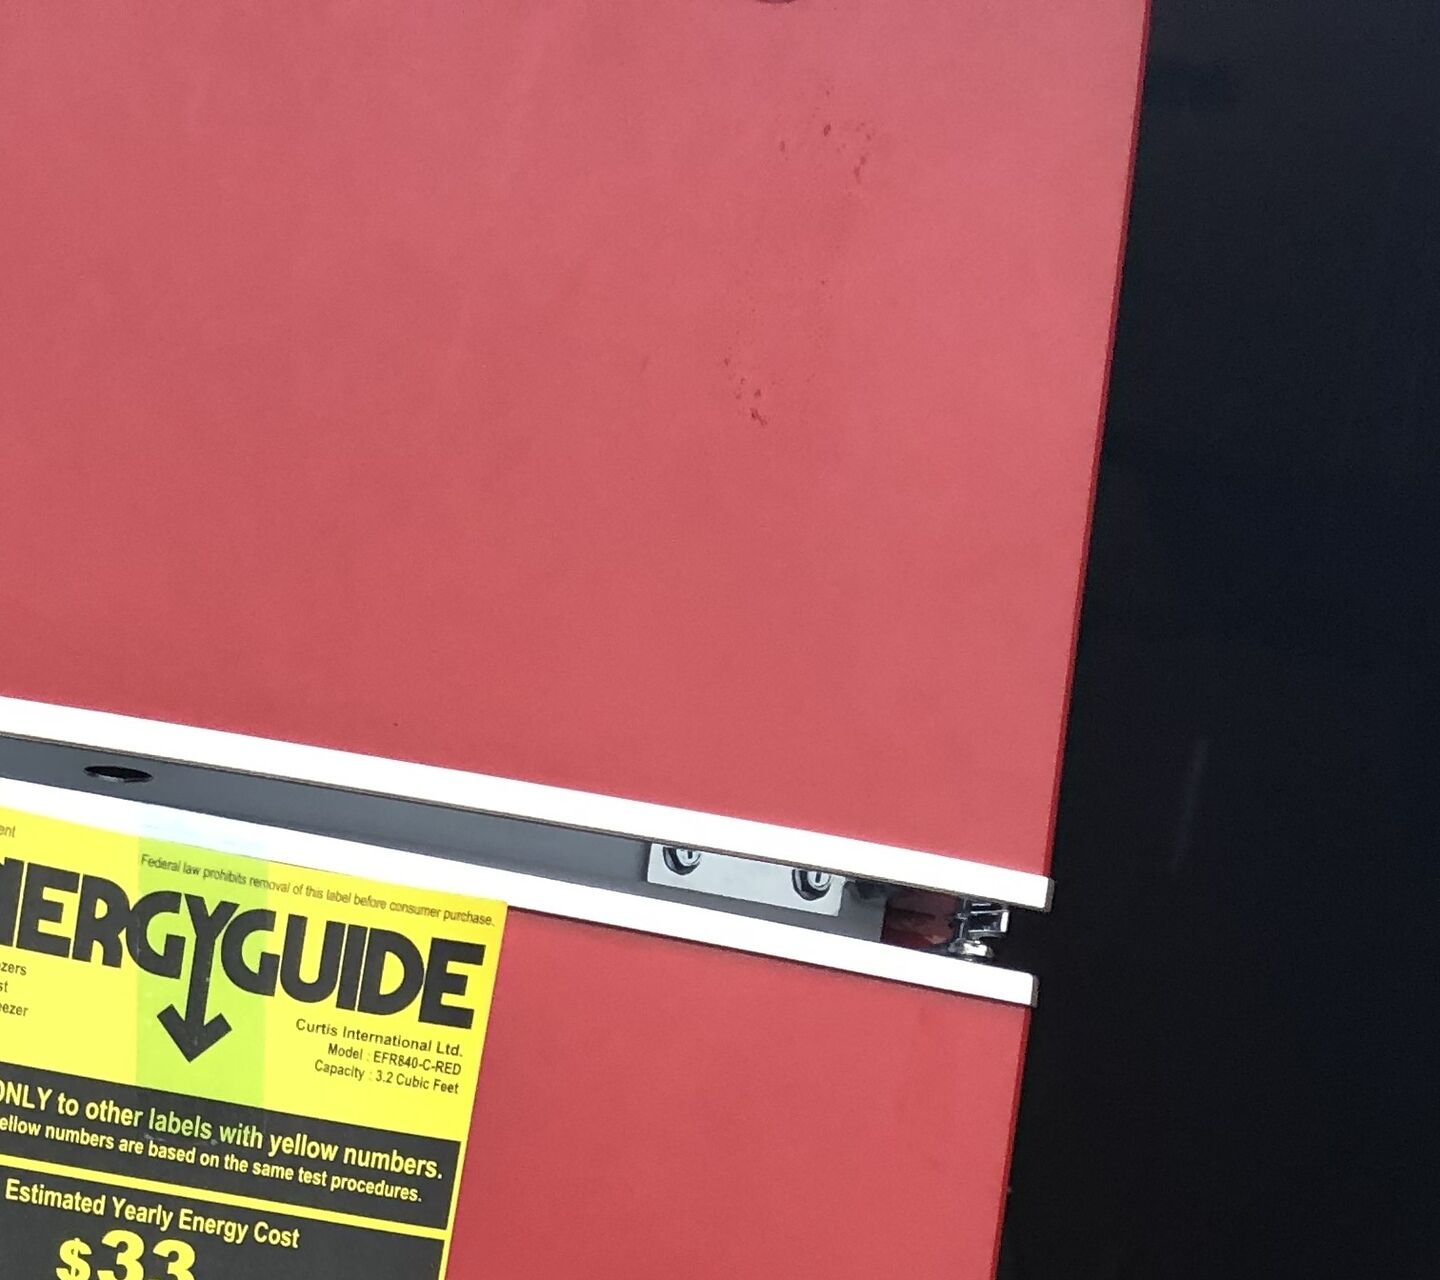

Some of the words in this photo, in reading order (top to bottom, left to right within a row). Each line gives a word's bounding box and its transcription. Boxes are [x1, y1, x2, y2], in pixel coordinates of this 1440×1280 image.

[140, 853, 181, 872] Federal
[182, 862, 201, 875] law
[202, 867, 246, 884] prohibits
[248, 876, 290, 892] removal
[292, 883, 303, 894] of
[305, 885, 323, 899] this
[326, 889, 351, 903] label
[353, 893, 387, 909] before
[389, 901, 441, 917] consumer
[442, 909, 494, 926] purchase.
[295, 1018, 337, 1036] Curtis
[342, 1026, 432, 1051] International
[435, 1041, 462, 1056] Ltd.
[327, 1042, 362, 1059] Model
[373, 1050, 461, 1075] EFR840-C-RED
[314, 1059, 364, 1081] Capacity
[375, 1069, 393, 1083] 3.2
[396, 1072, 429, 1089] Cubic
[432, 1078, 459, 1094] Feet
[44, 1125, 114, 1149] numbers
[118, 1138, 143, 1154] are
[147, 1139, 196, 1163] based
[199, 1152, 219, 1167] on
[224, 1153, 248, 1172] the
[251, 1161, 293, 1180] same
[298, 1166, 327, 1186] test
[330, 1175, 421, 1201] procedures.
[57, 1092, 78, 1115] to
[85, 1099, 143, 1126] other
[148, 1107, 211, 1139] labels
[219, 1122, 263, 1148] with
[267, 1132, 338, 1161] yellow
[343, 1147, 442, 1178] numbers.
[5, 1177, 105, 1215] Estimated
[112, 1196, 173, 1231] Yearly
[178, 1208, 248, 1244] Energy
[253, 1221, 299, 1248] Cost
